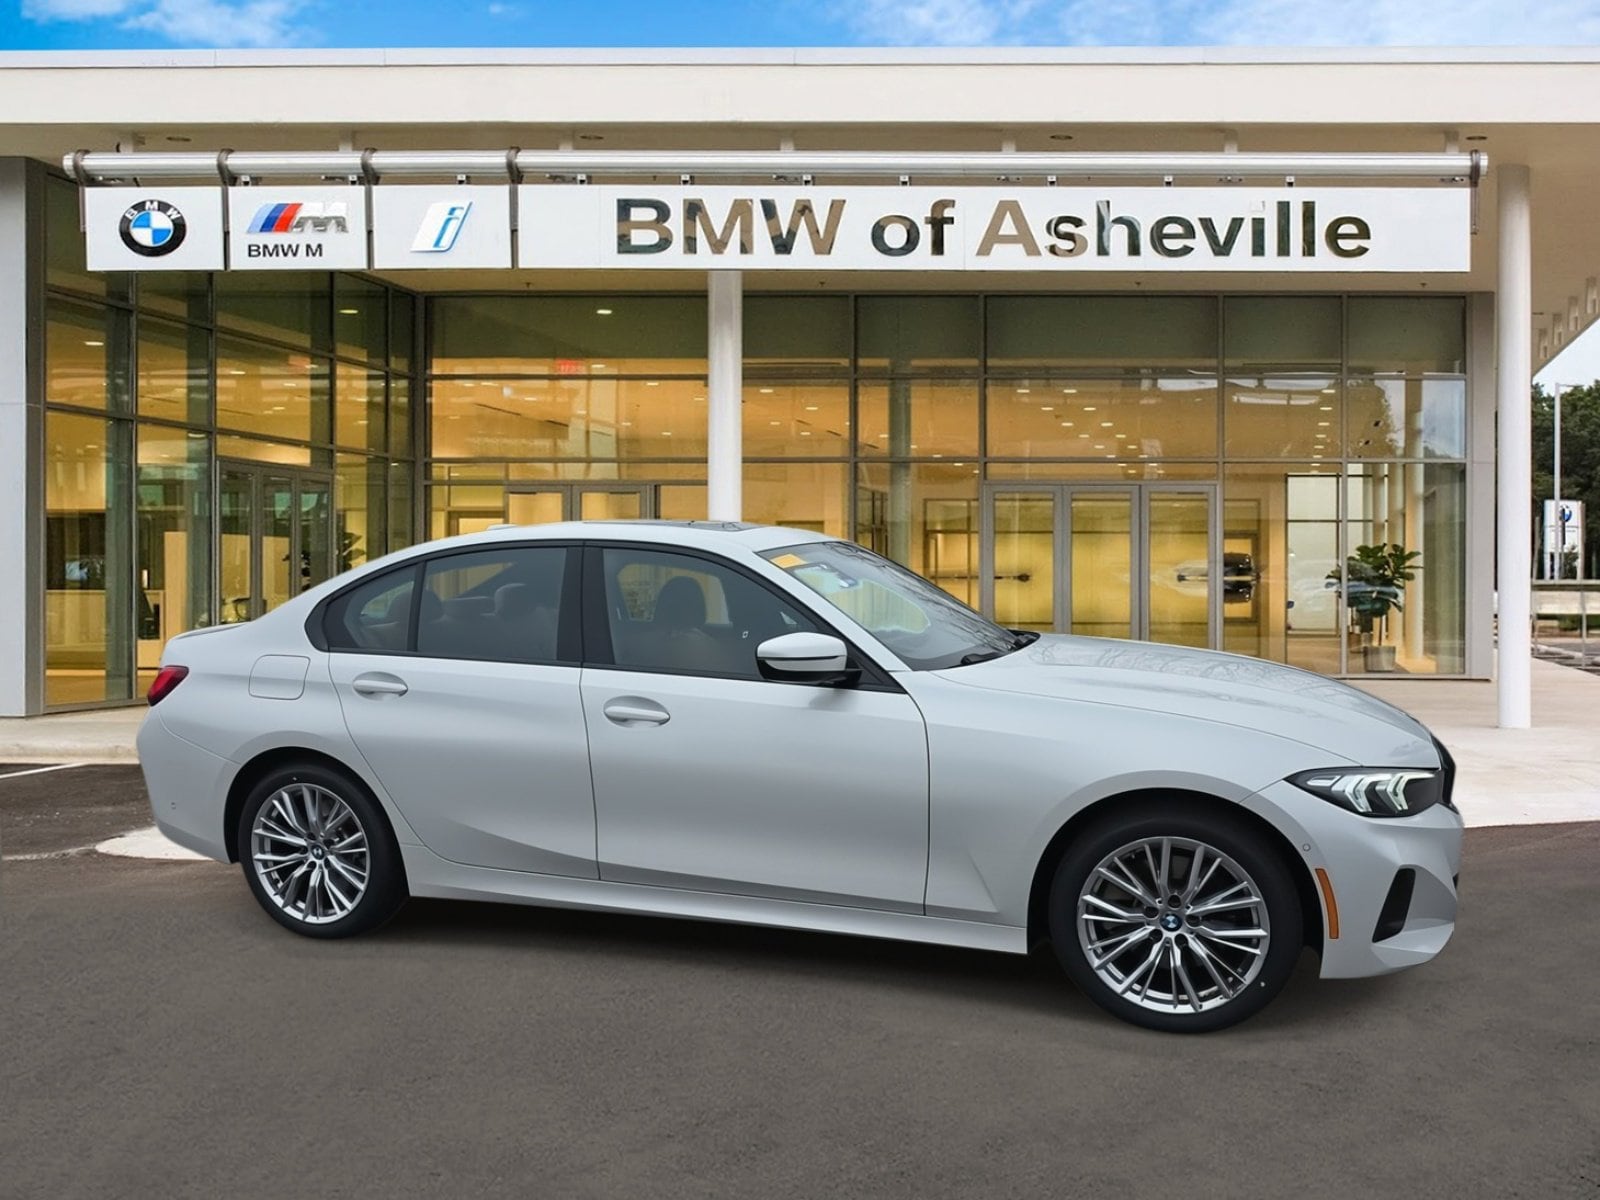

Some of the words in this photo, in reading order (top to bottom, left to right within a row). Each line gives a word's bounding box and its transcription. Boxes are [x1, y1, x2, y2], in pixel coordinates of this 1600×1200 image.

[125, 201, 181, 220] BMW
[616, 198, 847, 256] BMW
[871, 198, 957, 258] of
[975, 199, 1372, 259] Asheville
[247, 243, 300, 258] BMW
[305, 243, 323, 258] M
